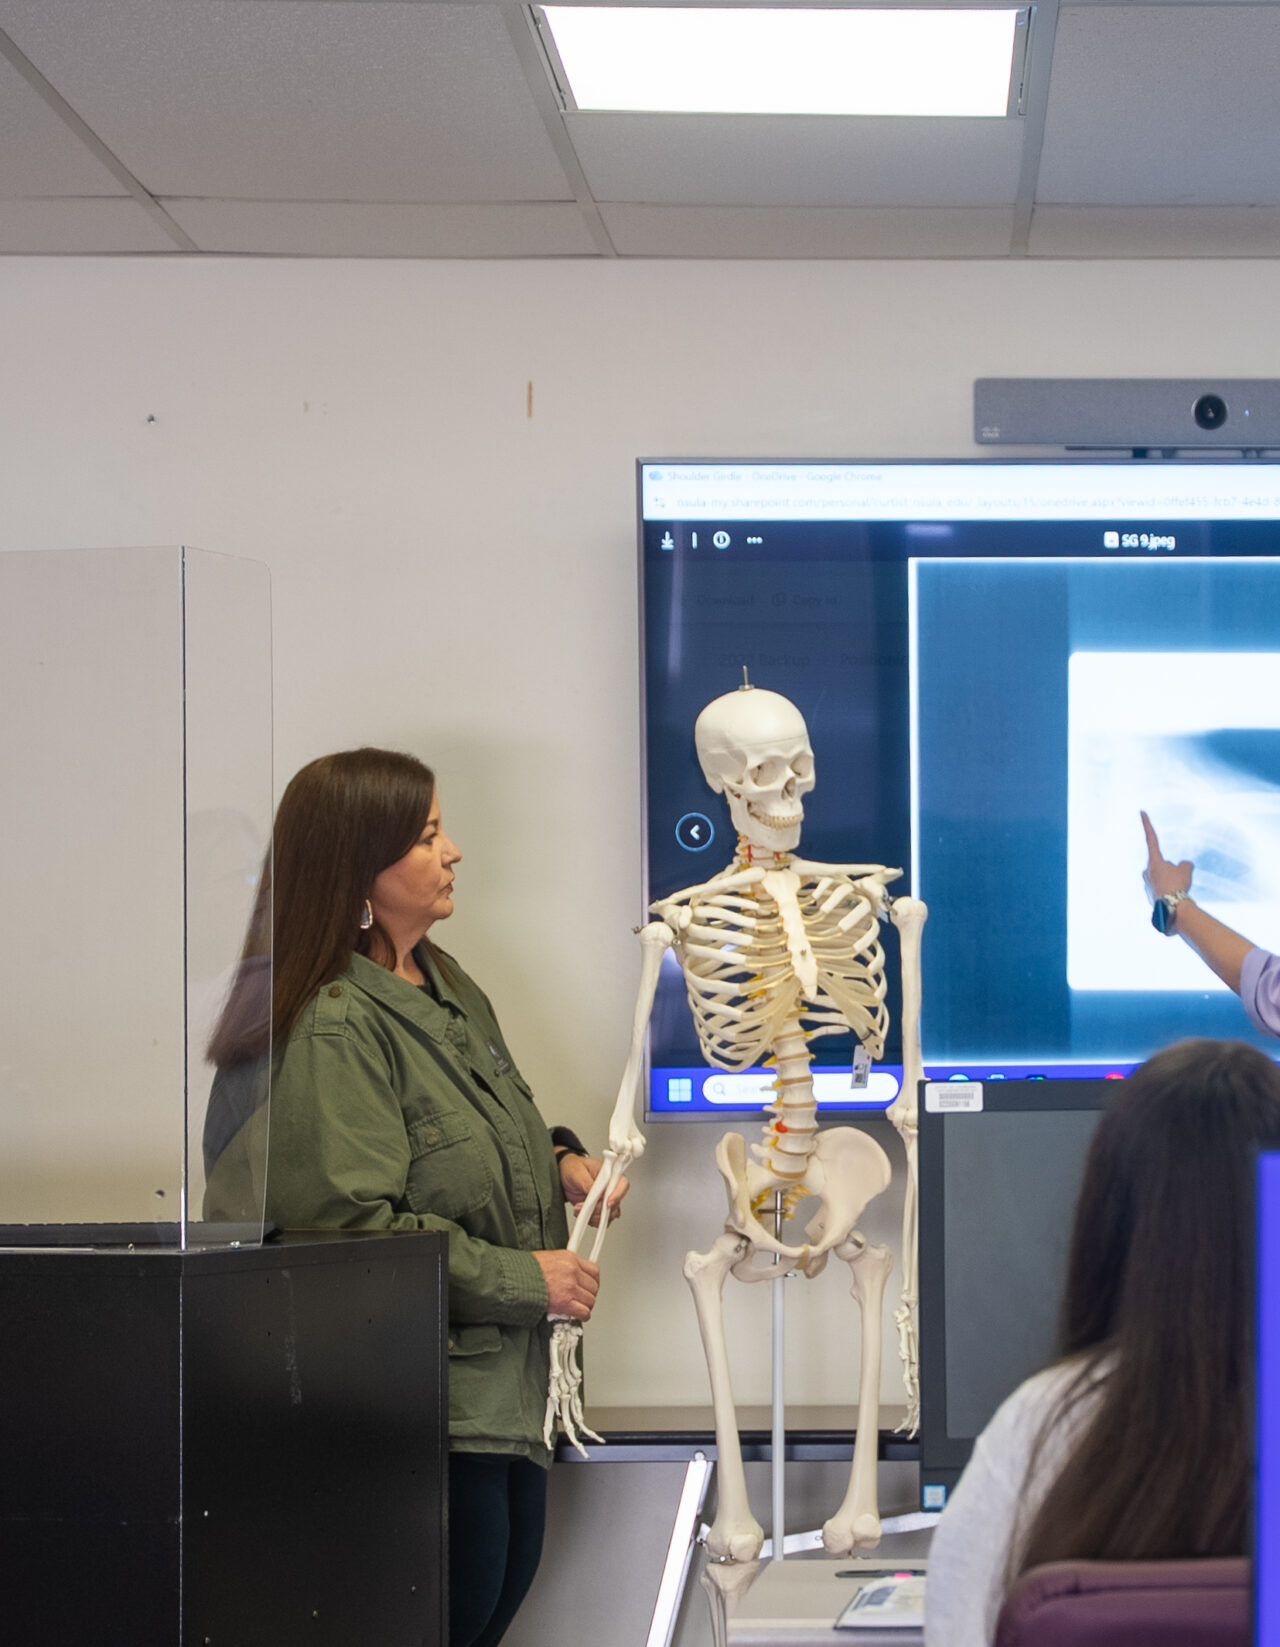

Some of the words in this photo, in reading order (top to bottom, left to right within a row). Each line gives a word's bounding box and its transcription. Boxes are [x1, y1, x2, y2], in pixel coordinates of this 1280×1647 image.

[667, 471, 710, 481] Shoulder
[713, 471, 742, 481] Girdle
[752, 471, 797, 481] OneDrive
[806, 471, 841, 484] Google
[844, 471, 882, 481] Chrome
[1121, 533, 1139, 548] SG
[1140, 533, 1176, 551] 9.jpeg
